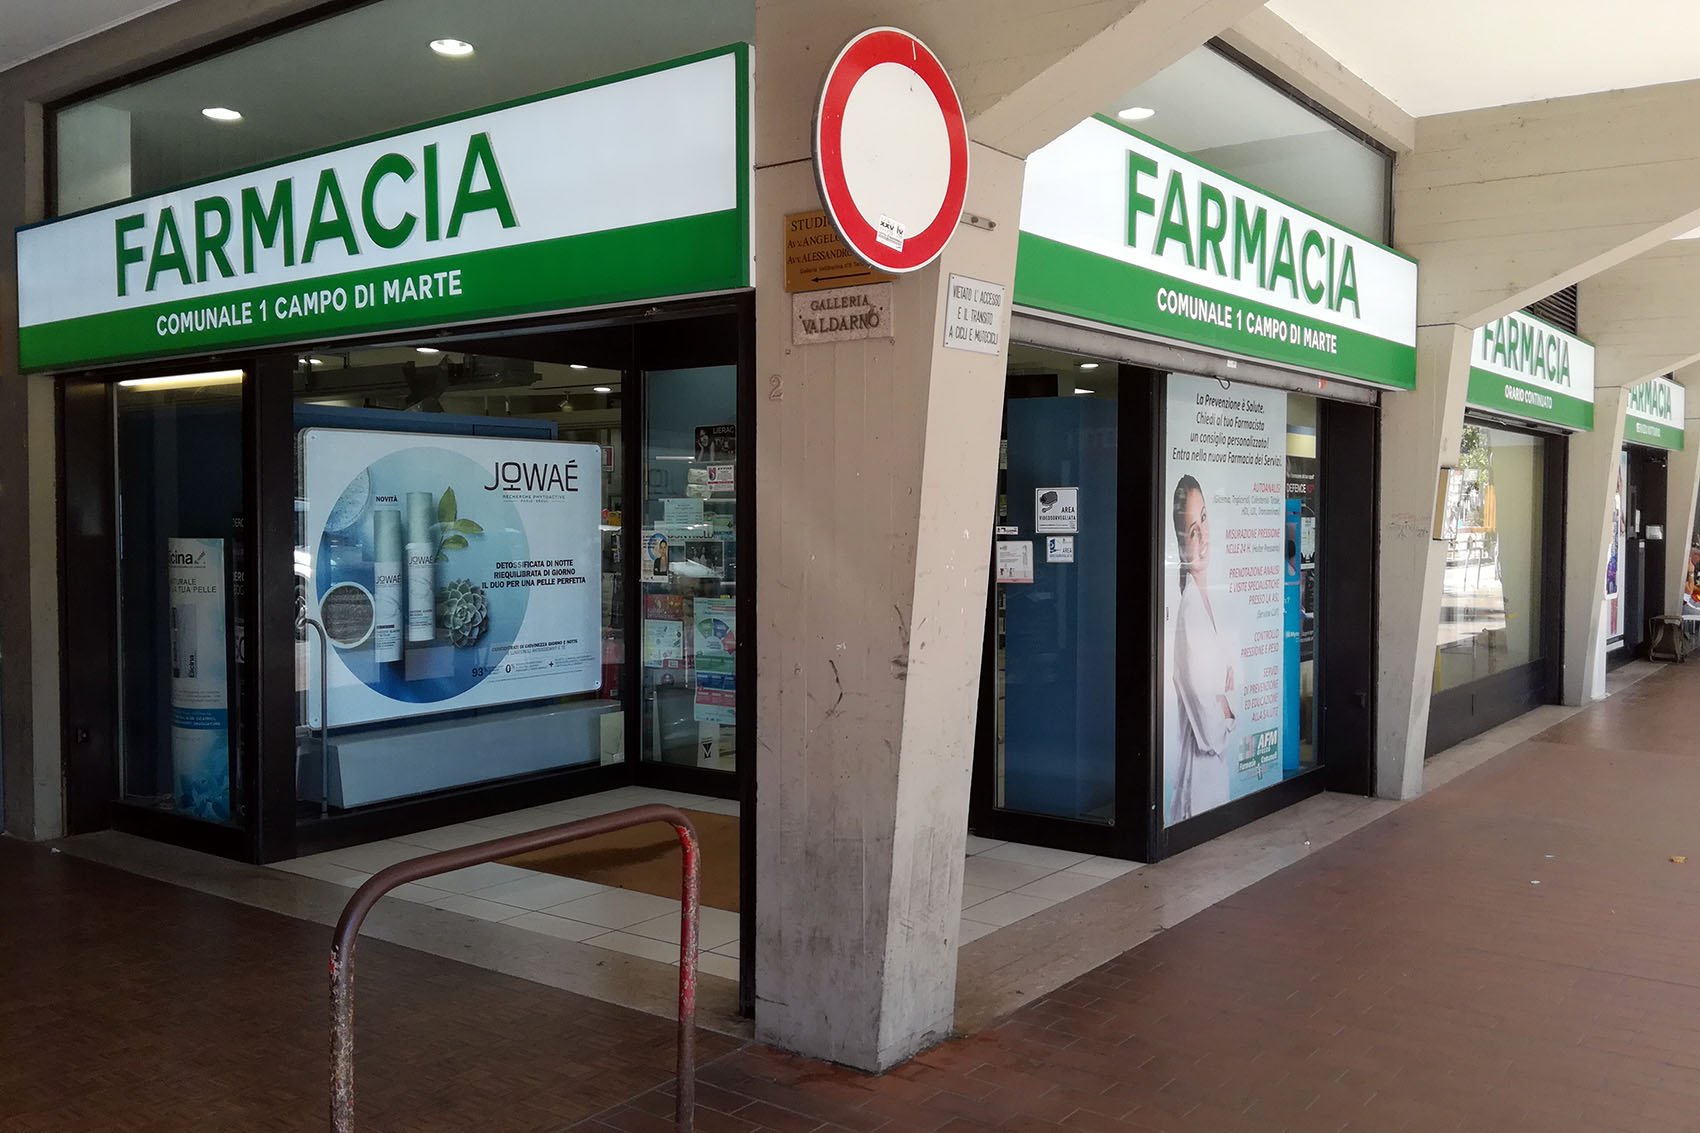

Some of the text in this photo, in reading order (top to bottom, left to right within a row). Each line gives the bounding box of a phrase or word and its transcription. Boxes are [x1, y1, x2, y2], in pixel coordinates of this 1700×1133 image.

[115, 131, 520, 297] FARMACIA
[791, 216, 830, 232] STUDI
[1123, 149, 1361, 319] FARMACIA
[156, 269, 464, 336] COMUNALE 1 CAMPO DI MARTE
[810, 294, 870, 311] GALLERIA
[953, 285, 972, 301] VIETATO
[980, 290, 1001, 307] ACCESSO
[802, 312, 880, 335] VALDARNO
[957, 306, 993, 325] E IL TRANSITO
[1156, 287, 1338, 354] COMUNALE 1 CAMPO DI MARTE
[948, 325, 998, 345] A CICLI E MOTOCICLI
[1482, 315, 1571, 388] FARMACIA
[769, 374, 783, 401] 2
[1505, 384, 1552, 410] ORARIO CONTINUATO
[1196, 392, 1264, 414] La Prevenzione è Salute.
[1627, 379, 1672, 421] ARMACIA
[713, 426, 734, 434] LIERAC
[1196, 411, 1265, 431] Chiedi al tuo Farmacista
[1190, 431, 1270, 449] un consiglio personalizzato!
[1172, 447, 1282, 467] Entra nella nuova Farmacia dei Servizi.
[484, 459, 578, 491] JOWAÉ
[494, 568, 576, 579] RIEQUILIBRATA DI GIORNO
[496, 560, 545, 569] DETOSSIFICATA
[546, 559, 553, 567] DI
[193, 585, 217, 593] PELLE
[482, 576, 586, 589] IL DUO PER UNA PELLE PERFETTA
[1257, 729, 1278, 749] AFM
